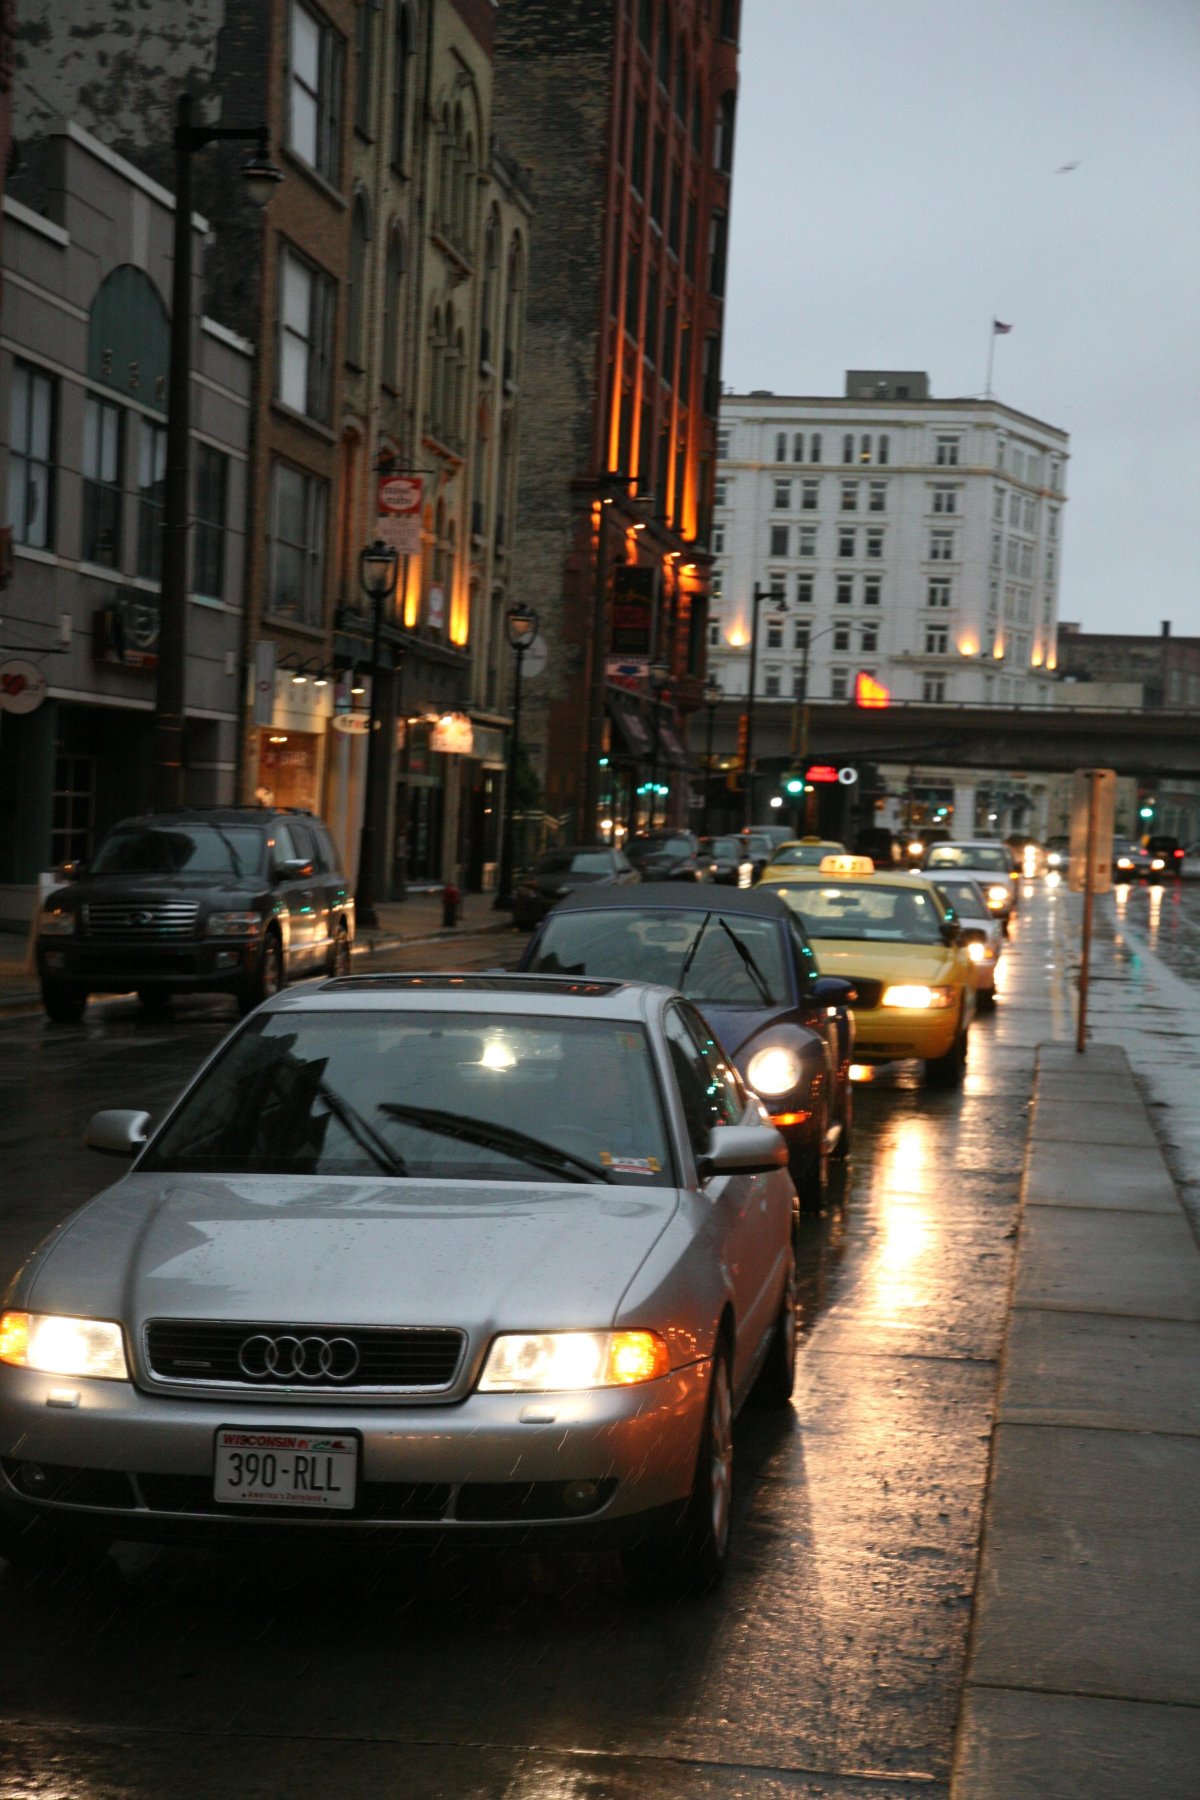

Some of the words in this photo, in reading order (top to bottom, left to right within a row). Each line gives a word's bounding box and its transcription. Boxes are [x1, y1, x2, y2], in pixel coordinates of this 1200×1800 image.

[829, 860, 866, 871] TAXI
[224, 1434, 297, 1448] WISCONSIN
[228, 1452, 341, 1492] 390-RLL
